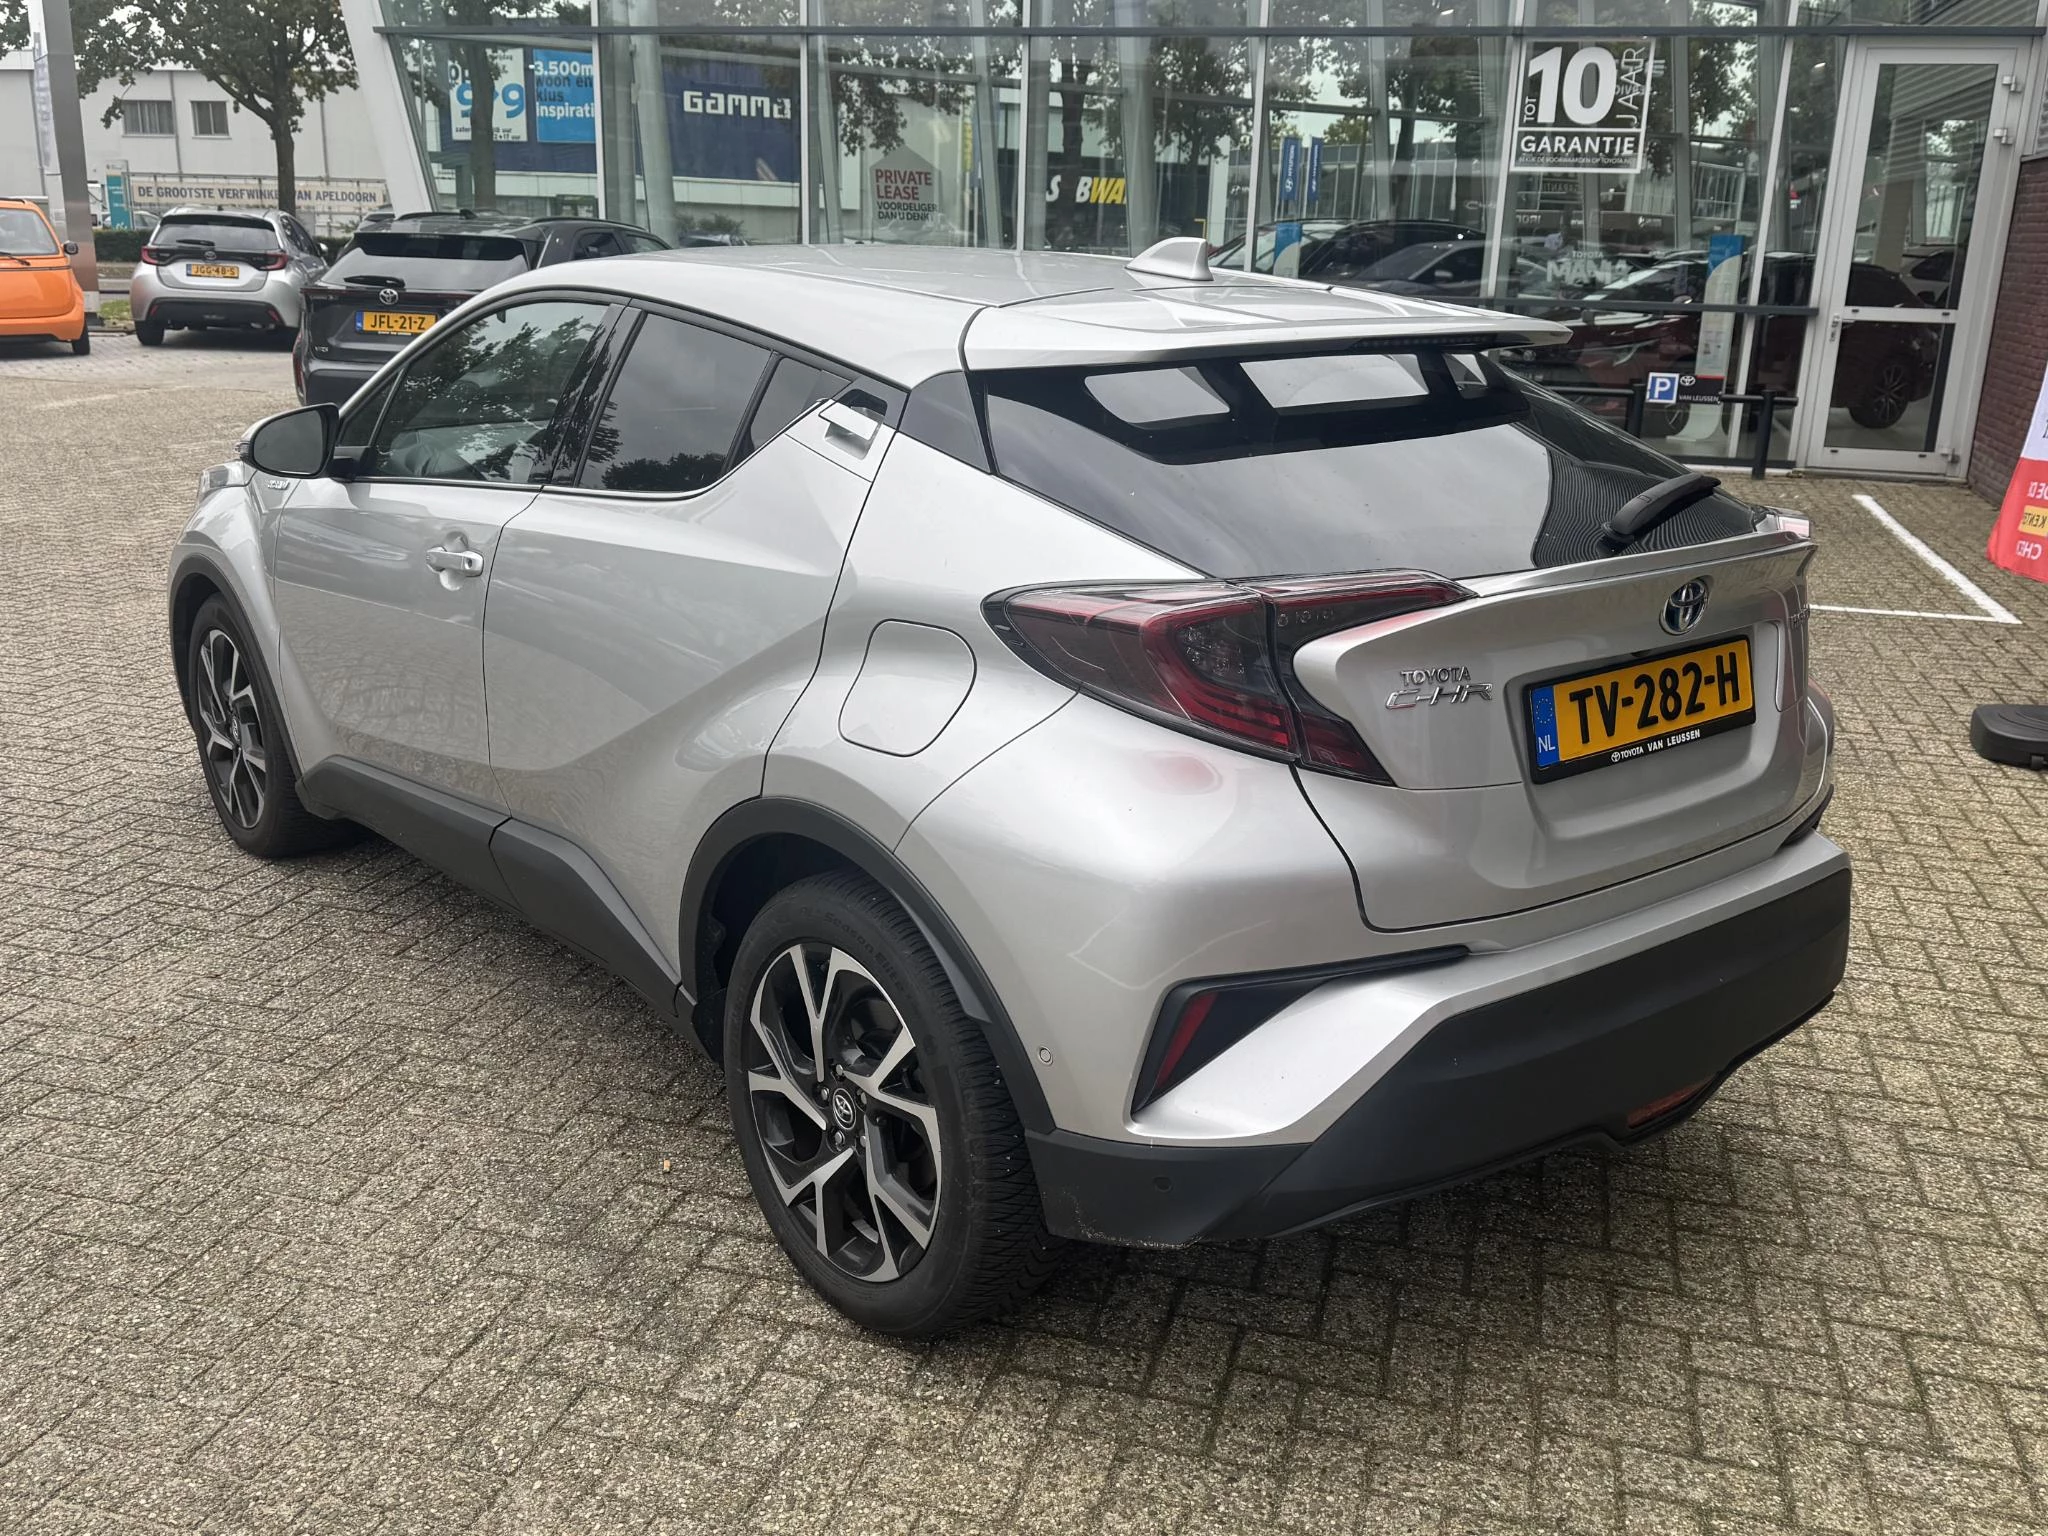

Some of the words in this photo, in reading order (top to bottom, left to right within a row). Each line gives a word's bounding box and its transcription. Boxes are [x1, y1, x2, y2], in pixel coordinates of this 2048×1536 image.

[1528, 47, 1617, 125] 10
[1616, 47, 1645, 129] JAAR
[536, 102, 595, 120] inspirati
[1523, 96, 1537, 123] TOT
[1521, 136, 1635, 155] GARANTIE
[875, 169, 933, 186] PRIVATE
[138, 187, 153, 198] DE
[156, 187, 215, 199] GROOTSTE
[217, 188, 279, 200] VERFWINKE
[294, 190, 311, 201] AN
[315, 191, 377, 202] APELDOORN
[877, 185, 919, 201] LEASE
[1045, 174, 1127, 205] SBWA
[878, 211, 897, 219] DAN
[899, 212, 905, 220] U
[906, 212, 930, 220] DENK
[370, 314, 426, 331] JFL-21-Z
[1653, 377, 1671, 399] P
[1401, 666, 1471, 686] TOYOTA
[1385, 683, 1493, 710] C-HR
[1569, 651, 1741, 745] TV-282-H
[1538, 734, 1556, 754] NL
[1620, 747, 1644, 760] TOYOTA
[1647, 740, 1664, 752] VAN
[1666, 729, 1701, 748] LEUSSEN
